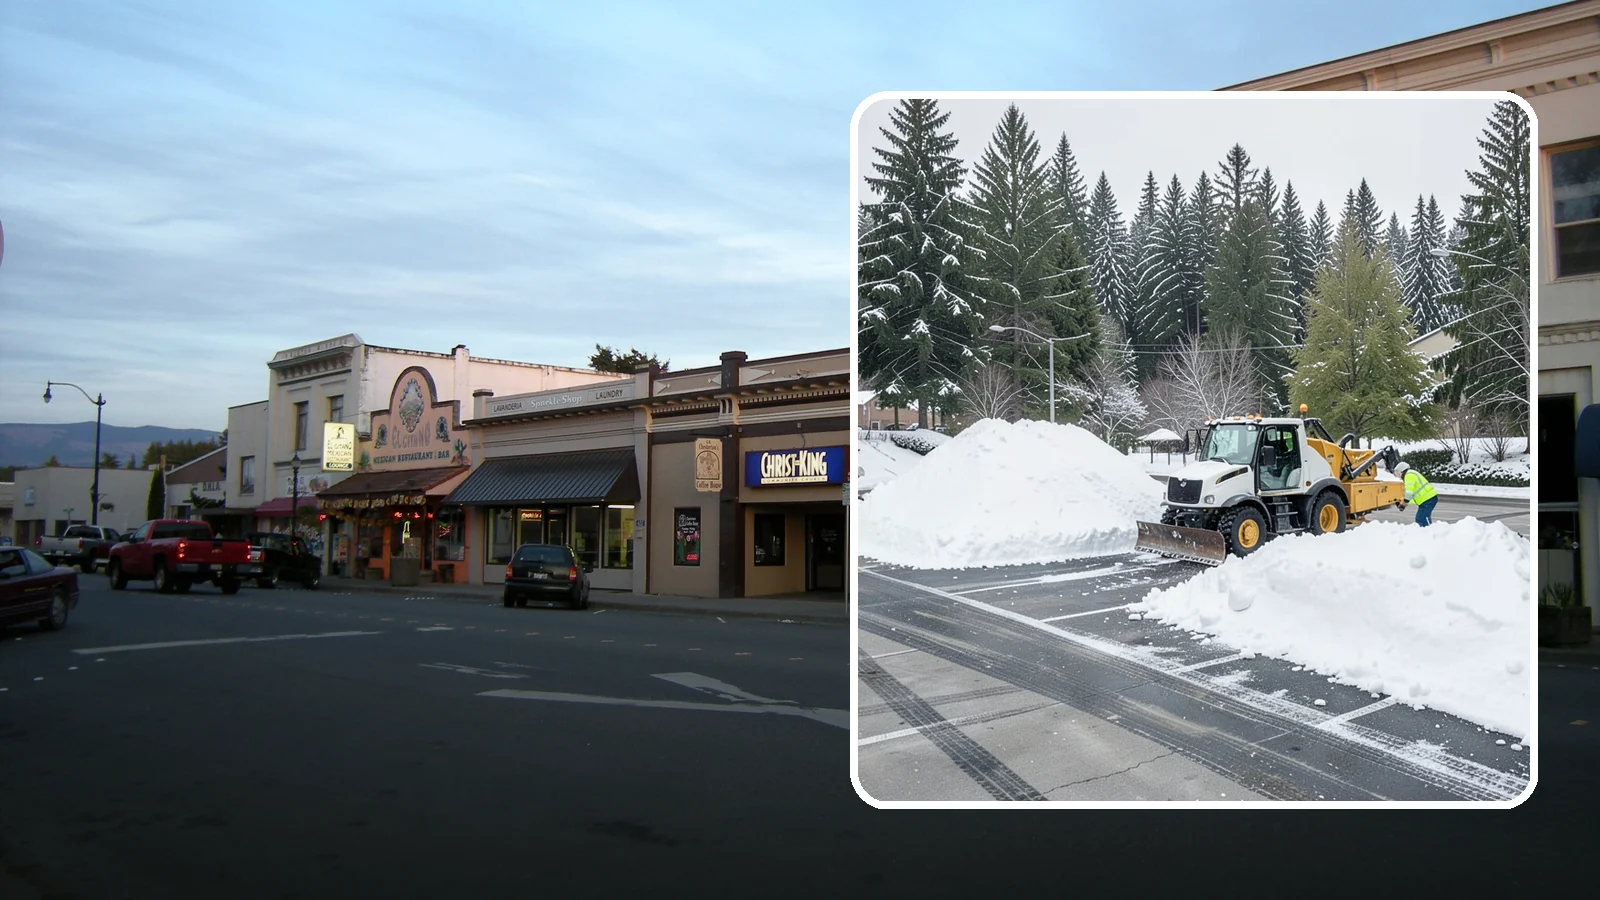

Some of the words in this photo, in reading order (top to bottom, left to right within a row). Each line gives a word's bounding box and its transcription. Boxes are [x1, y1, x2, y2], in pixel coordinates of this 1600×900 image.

[595, 389, 624, 400] LAUNDRY
[493, 402, 522, 413] LAVANDERIA
[530, 399, 560, 409] Sparkle
[562, 395, 582, 405] Shop
[392, 425, 402, 449] EL
[373, 455, 396, 465] MEXICAN
[397, 451, 433, 462] RESTAURANT
[438, 450, 450, 459] BAR
[761, 452, 798, 478] CHRIST
[799, 450, 827, 477] KING
[696, 480, 709, 489] Coffee
